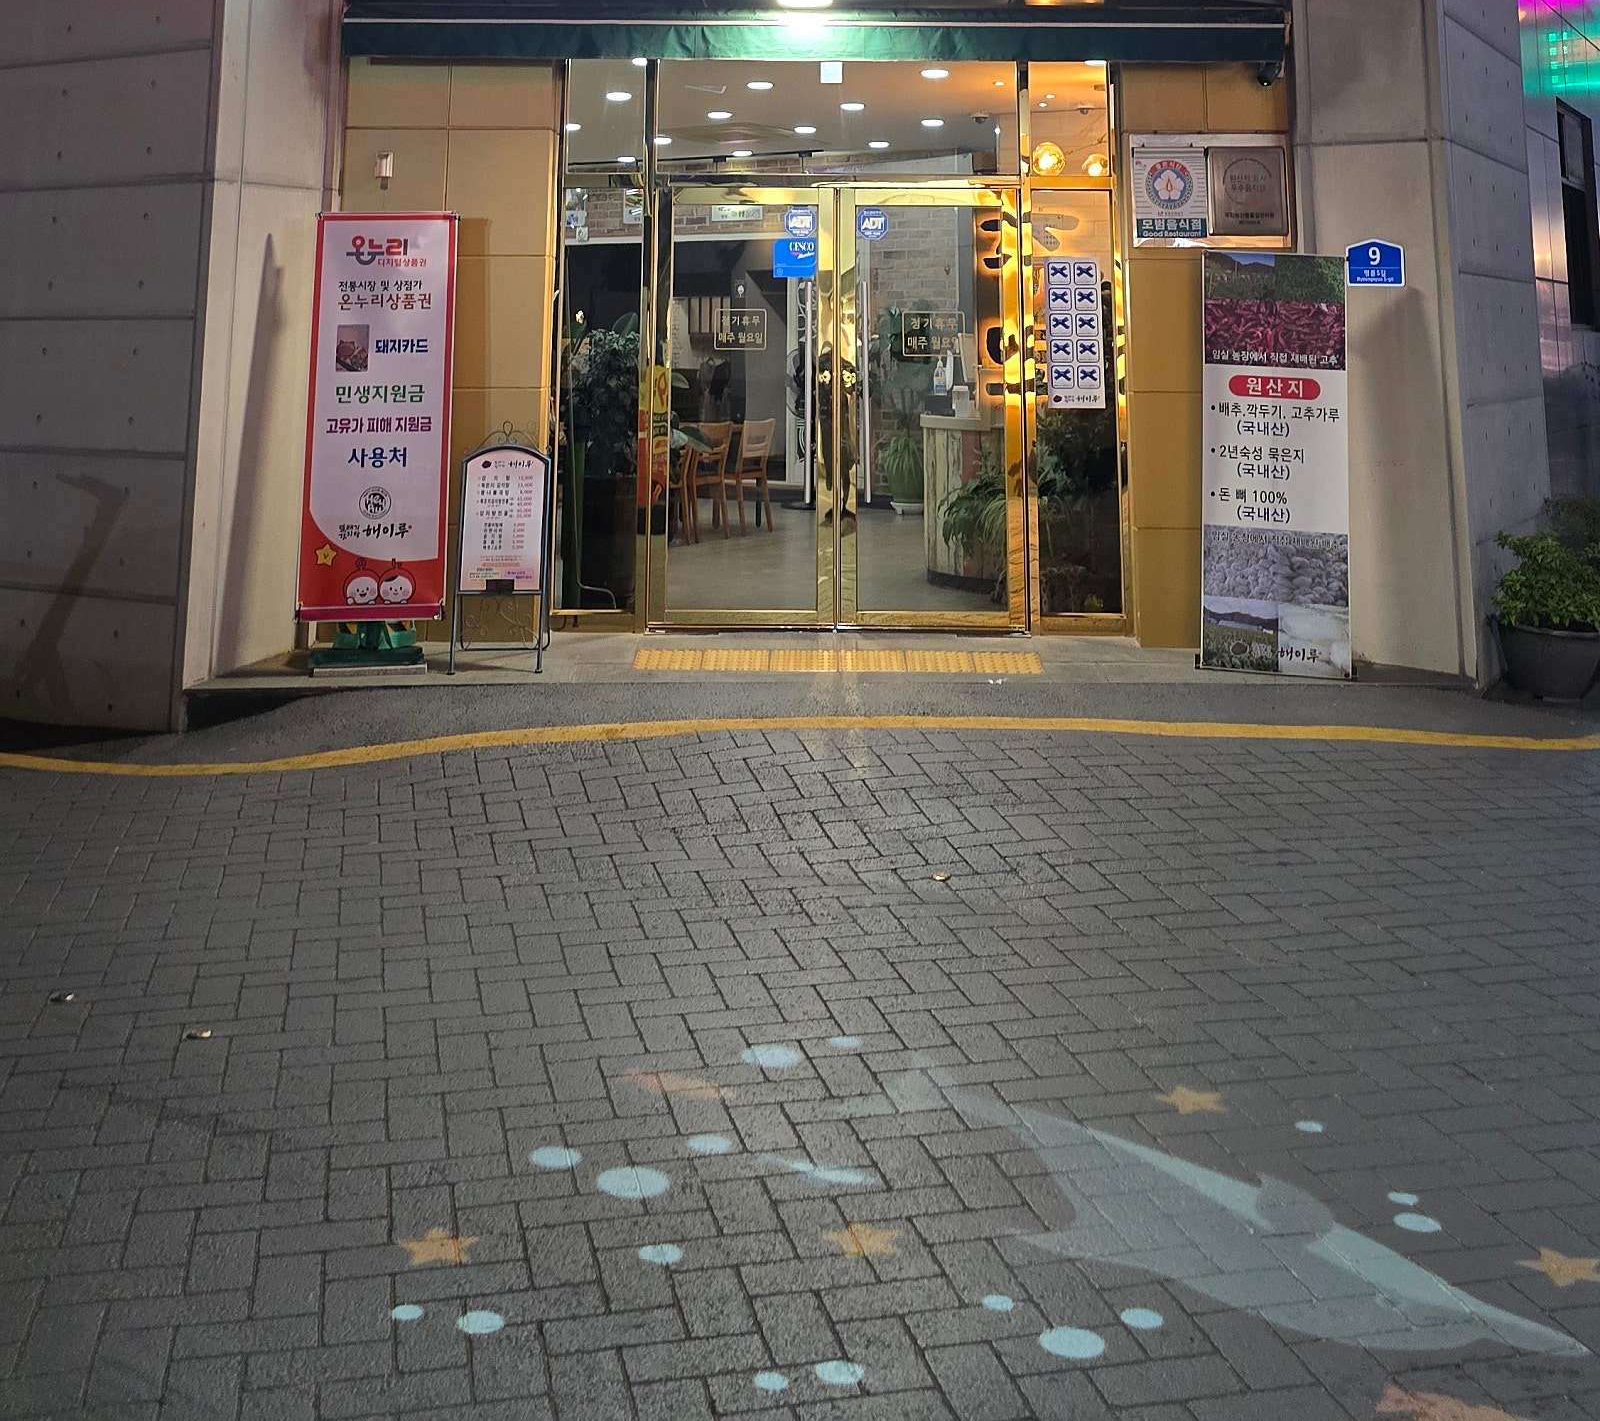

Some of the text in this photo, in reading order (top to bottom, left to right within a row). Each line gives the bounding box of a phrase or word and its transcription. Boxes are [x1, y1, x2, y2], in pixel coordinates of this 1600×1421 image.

[789, 215, 812, 228] ADT
[861, 217, 884, 230] ADT
[1142, 219, 1202, 230] 모범음식점
[346, 235, 408, 266] 온누리
[789, 241, 815, 251] CESCO
[378, 258, 427, 267] 디지털상품권
[1368, 246, 1381, 266] 9
[338, 280, 422, 292] 전통시장 및 상점가
[338, 292, 432, 311] 온누리상품권
[722, 315, 760, 326] 정기휴무
[911, 316, 957, 330] 정기휴무
[375, 338, 429, 354] 돼지카드
[718, 332, 763, 344] 매주 월요일
[907, 336, 928, 350] 매주
[1212, 349, 1229, 360] 임실
[1231, 351, 1267, 362] 농장에서
[1270, 352, 1287, 363] 직접
[335, 384, 425, 404] 민생지원금
[1246, 377, 1303, 398] 원산지
[1291, 406, 1340, 422] 고추가루
[326, 416, 432, 434] 고유가 피해 지원금
[1237, 420, 1290, 437] (국내산)
[347, 446, 408, 469] 사용처
[1219, 445, 1304, 464] 2년숙성 묵은지
[1237, 462, 1291, 480] (국내산)
[1219, 487, 1287, 505] 돈 뼈 100%
[1237, 505, 1291, 524] (국내산)
[362, 523, 409, 539] 해이루
[1276, 646, 1319, 663] 해이루
